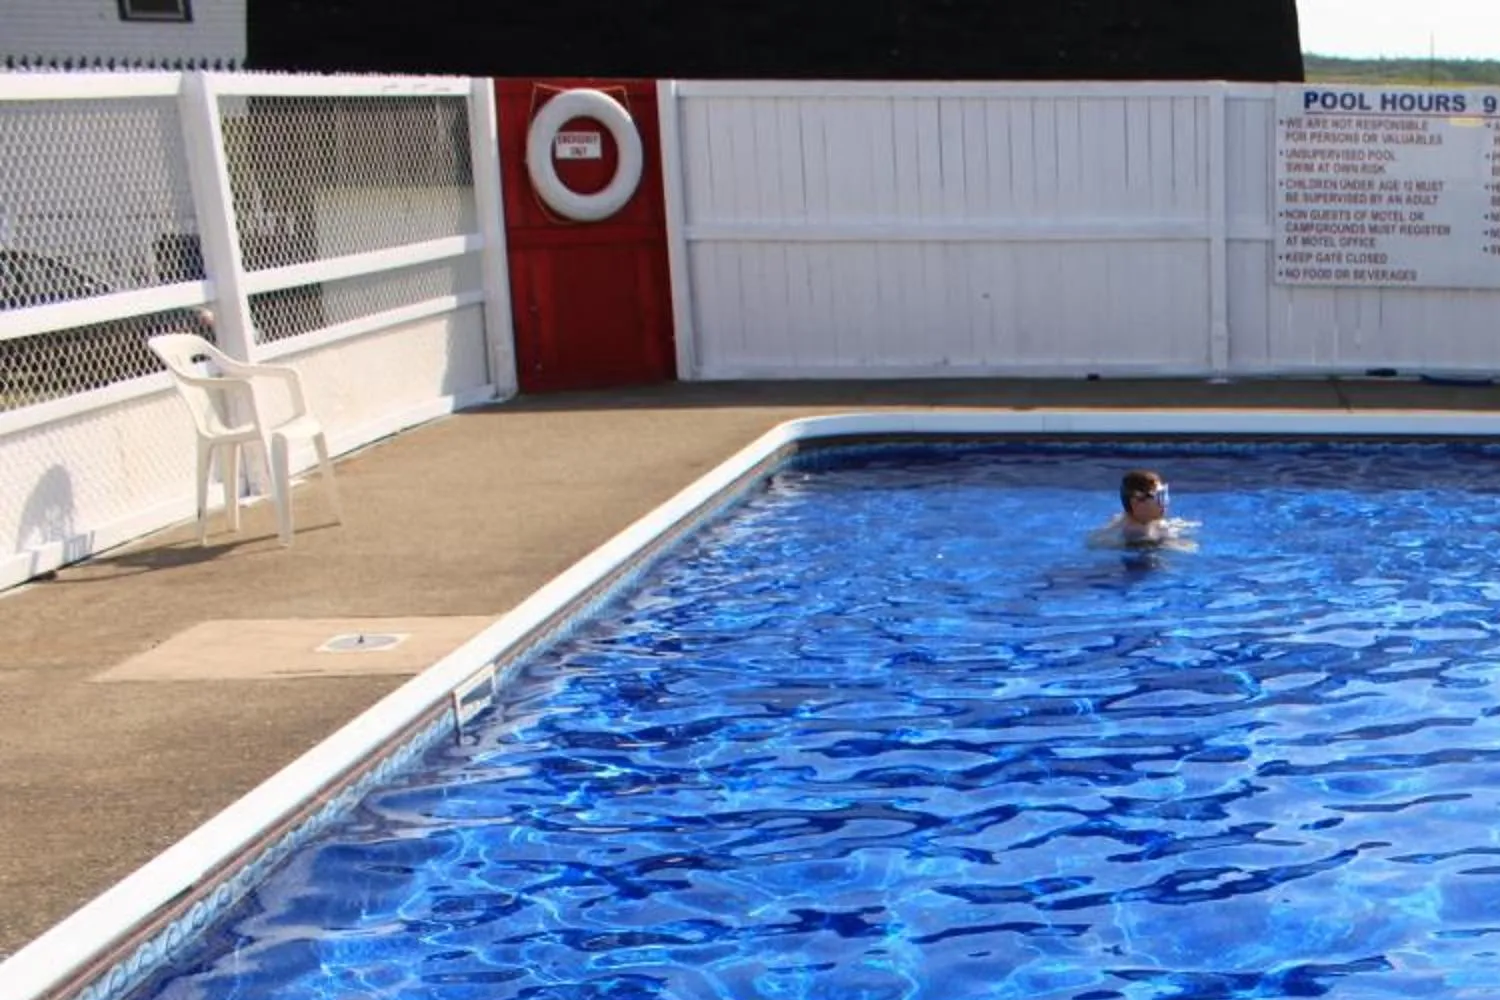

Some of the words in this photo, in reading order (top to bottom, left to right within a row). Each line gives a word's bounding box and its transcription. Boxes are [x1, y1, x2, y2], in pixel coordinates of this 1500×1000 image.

[1304, 91, 1372, 110] POOL
[1380, 93, 1466, 113] HOURS
[1483, 95, 1497, 113] 9
[1307, 118, 1327, 129] ARE
[1331, 118, 1352, 129] NOT
[1356, 119, 1428, 130] RESPONSIBLE
[1286, 131, 1306, 143] FOR
[1310, 132, 1360, 144] PERSONS
[1362, 133, 1378, 144] OR
[1381, 133, 1443, 145] VALUABLES
[1286, 149, 1366, 160] UNSUPERVISED
[1368, 150, 1395, 161] POOL
[1286, 162, 1314, 173] SWIM
[1318, 162, 1331, 173] AT
[1334, 163, 1358, 174] OWN
[1361, 163, 1386, 174] RISK
[1286, 179, 1338, 190] CHILDREN
[1339, 180, 1374, 191] UNDER
[1379, 180, 1399, 191] AGE
[1416, 181, 1444, 192] MUST
[1286, 192, 1299, 203] BE
[1303, 192, 1367, 204] SUPERVISED
[1370, 194, 1383, 204] BY
[1387, 194, 1402, 205] AN
[1405, 194, 1438, 206] ADULT
[1310, 210, 1351, 221] GUESTS
[1353, 210, 1367, 221] OF
[1370, 210, 1404, 221] MOTEL
[1409, 211, 1424, 221] OR
[1368, 223, 1396, 235] MUST
[1400, 224, 1451, 236] REGISTER
[1286, 236, 1298, 246] AT
[1301, 236, 1336, 247] MOTEL
[1339, 237, 1376, 248] OFFICE
[1286, 252, 1312, 263] KEEP
[1316, 252, 1343, 264] GATE
[1346, 253, 1388, 264] CLOSED
[1285, 268, 1300, 279] NO
[1303, 268, 1332, 280] FOOD
[1334, 269, 1350, 280] OR
[1353, 269, 1418, 281] BEVERAGES
